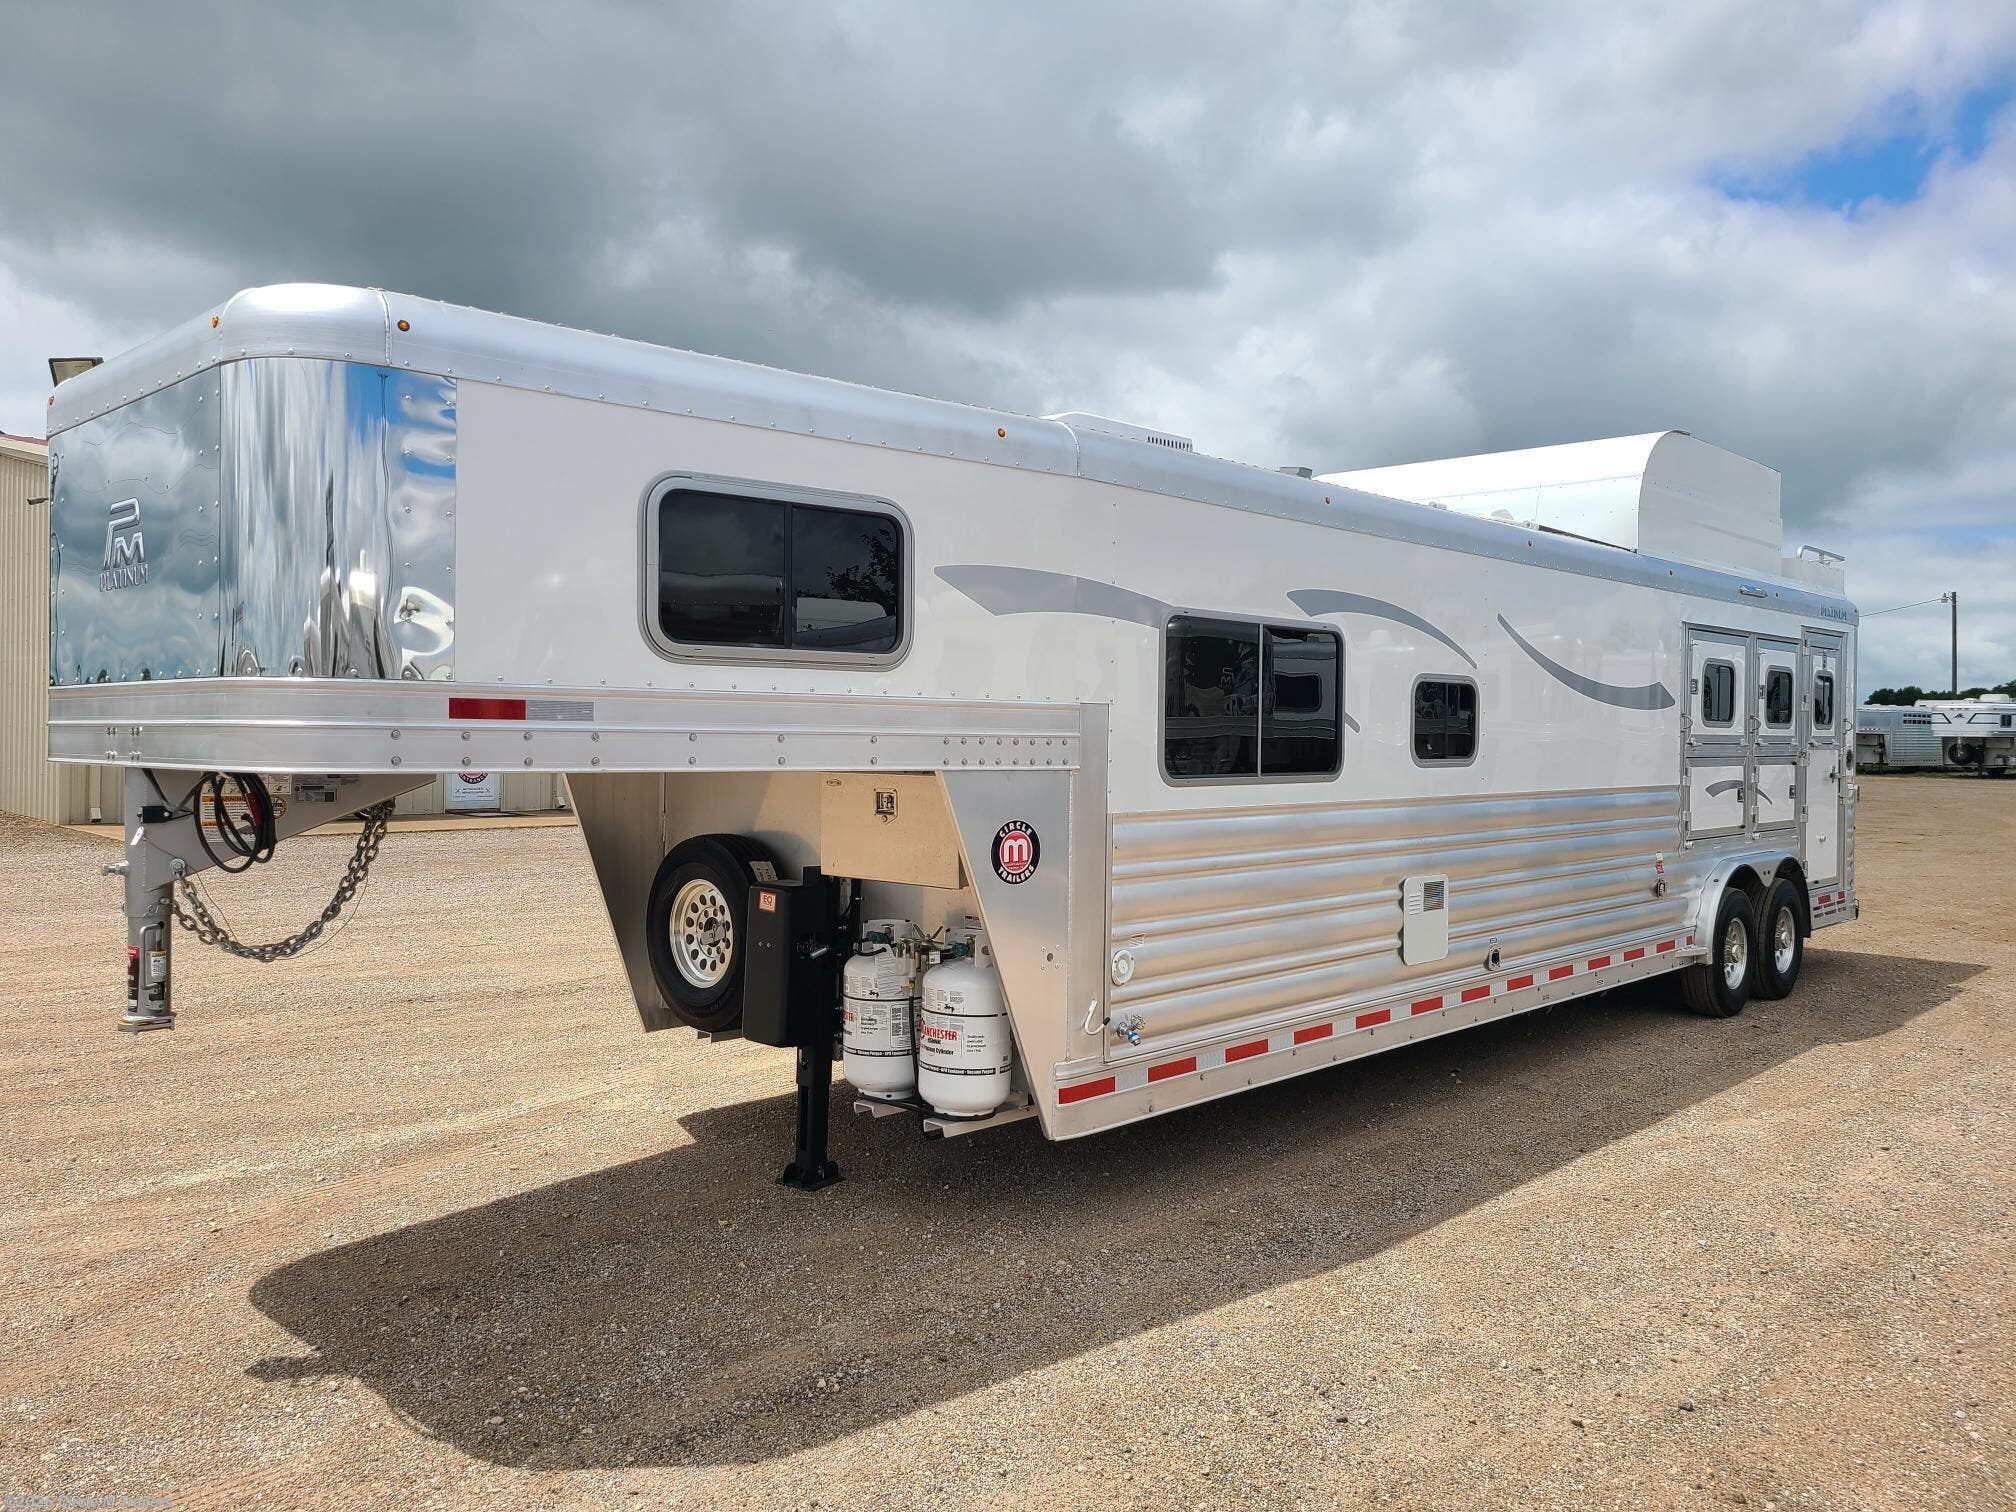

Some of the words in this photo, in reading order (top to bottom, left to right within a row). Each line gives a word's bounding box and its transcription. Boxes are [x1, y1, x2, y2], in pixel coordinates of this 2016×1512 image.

[99, 563, 149, 592] PLATINUM
[1820, 603, 1848, 621] PLATINUM
[1000, 821, 1032, 838] CIRCLE
[998, 865, 1034, 883] TRAILERS
[763, 894, 773, 907] EQ
